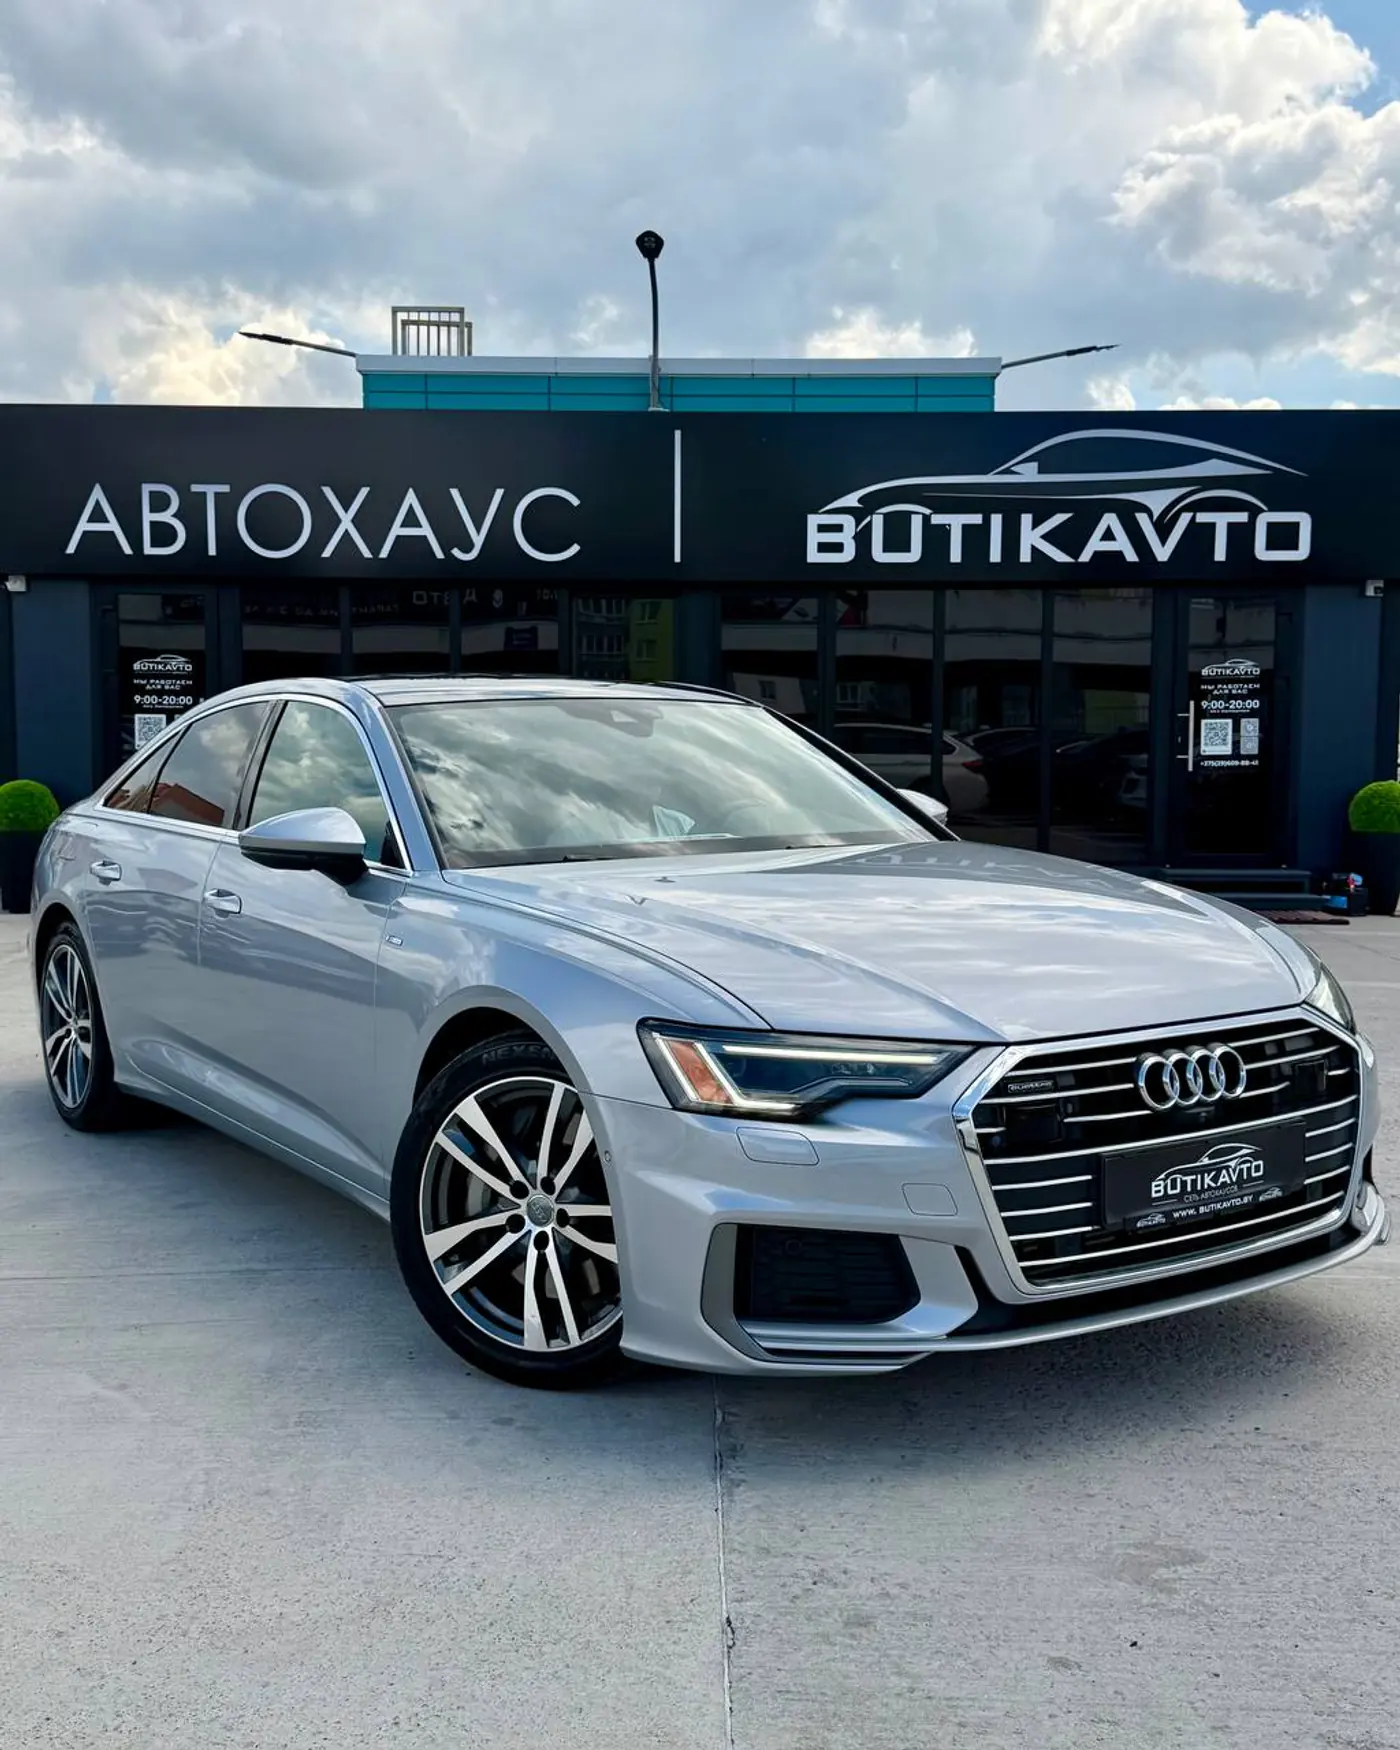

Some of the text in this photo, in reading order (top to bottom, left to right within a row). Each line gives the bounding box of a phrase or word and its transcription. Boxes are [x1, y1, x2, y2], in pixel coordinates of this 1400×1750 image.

[65, 482, 582, 562] АВТОХАУС
[806, 510, 1312, 563] BUTIKAVTO
[134, 695, 192, 704] 9:00-20:00
[1201, 700, 1259, 709] 9:00-20:00
[1151, 1160, 1264, 1198] BUTIKAVTO
